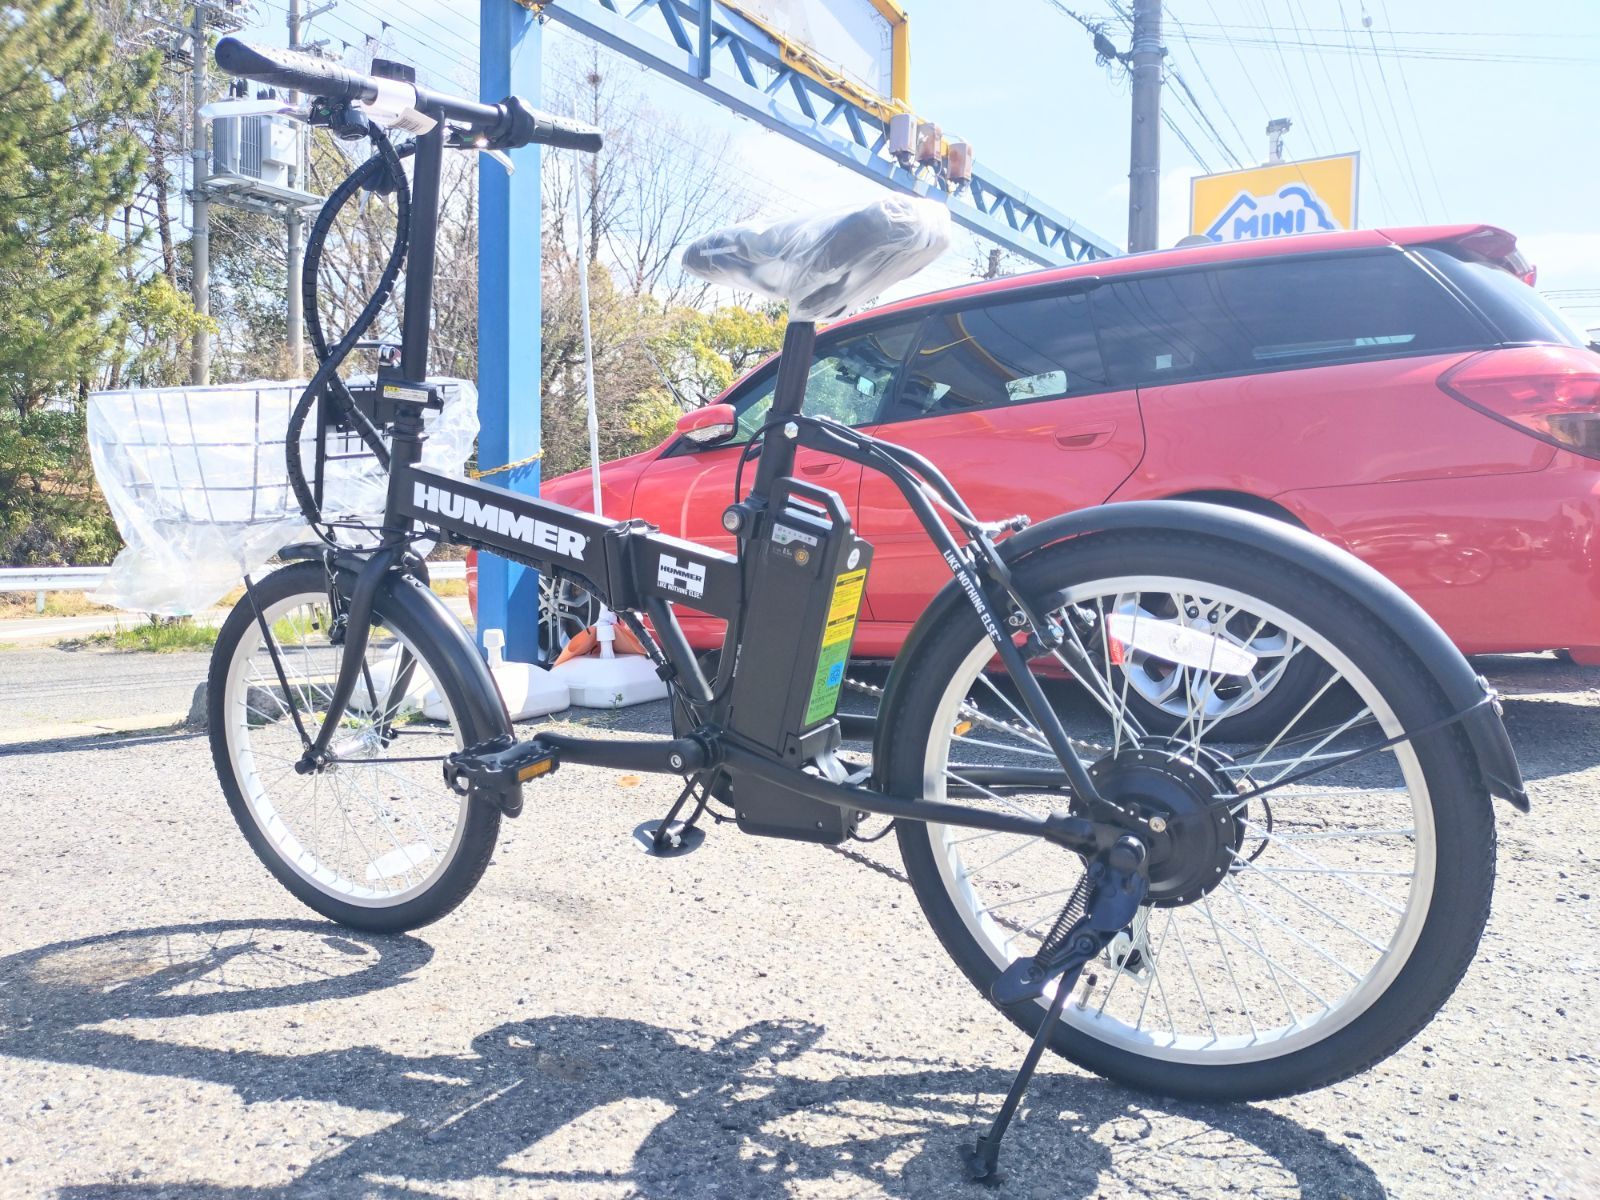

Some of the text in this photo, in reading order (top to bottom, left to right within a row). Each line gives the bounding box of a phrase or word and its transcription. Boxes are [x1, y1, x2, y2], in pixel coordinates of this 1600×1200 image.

[1234, 208, 1306, 240] MINI
[660, 565, 702, 582] HUMMER
[943, 549, 962, 573] LIKE
[957, 570, 986, 615] NOTHING
